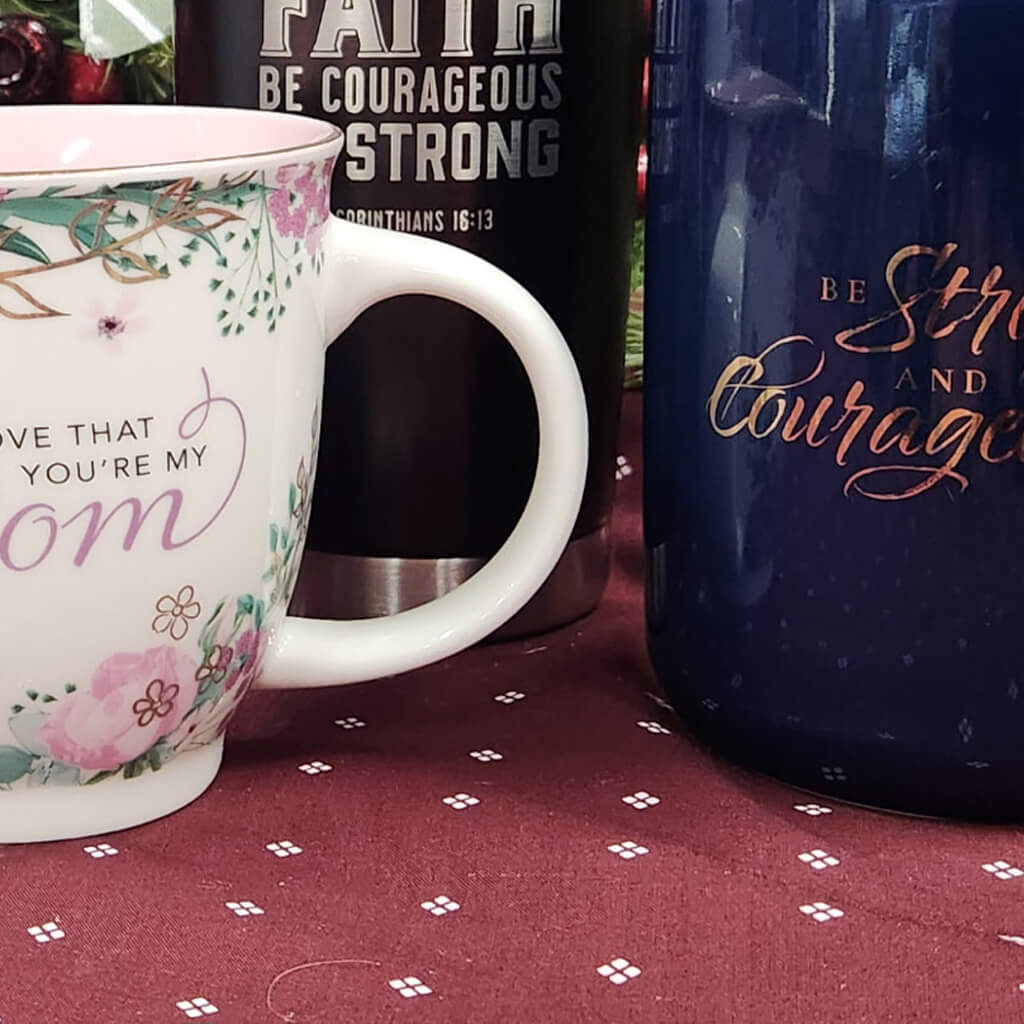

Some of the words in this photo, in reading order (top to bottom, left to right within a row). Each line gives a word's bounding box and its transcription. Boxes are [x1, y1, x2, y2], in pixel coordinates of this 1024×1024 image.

[259, 65, 304, 113] BE
[321, 62, 563, 114] COURAGEOUS
[345, 119, 561, 184] STRONG
[453, 208, 494, 232] 16:13
[820, 276, 867, 304] BE
[894, 367, 988, 395] AND
[68, 416, 156, 447] THAT
[707, 334, 1024, 501] Courage
[20, 454, 152, 487] YOU'RE
[166, 445, 209, 473] MY
